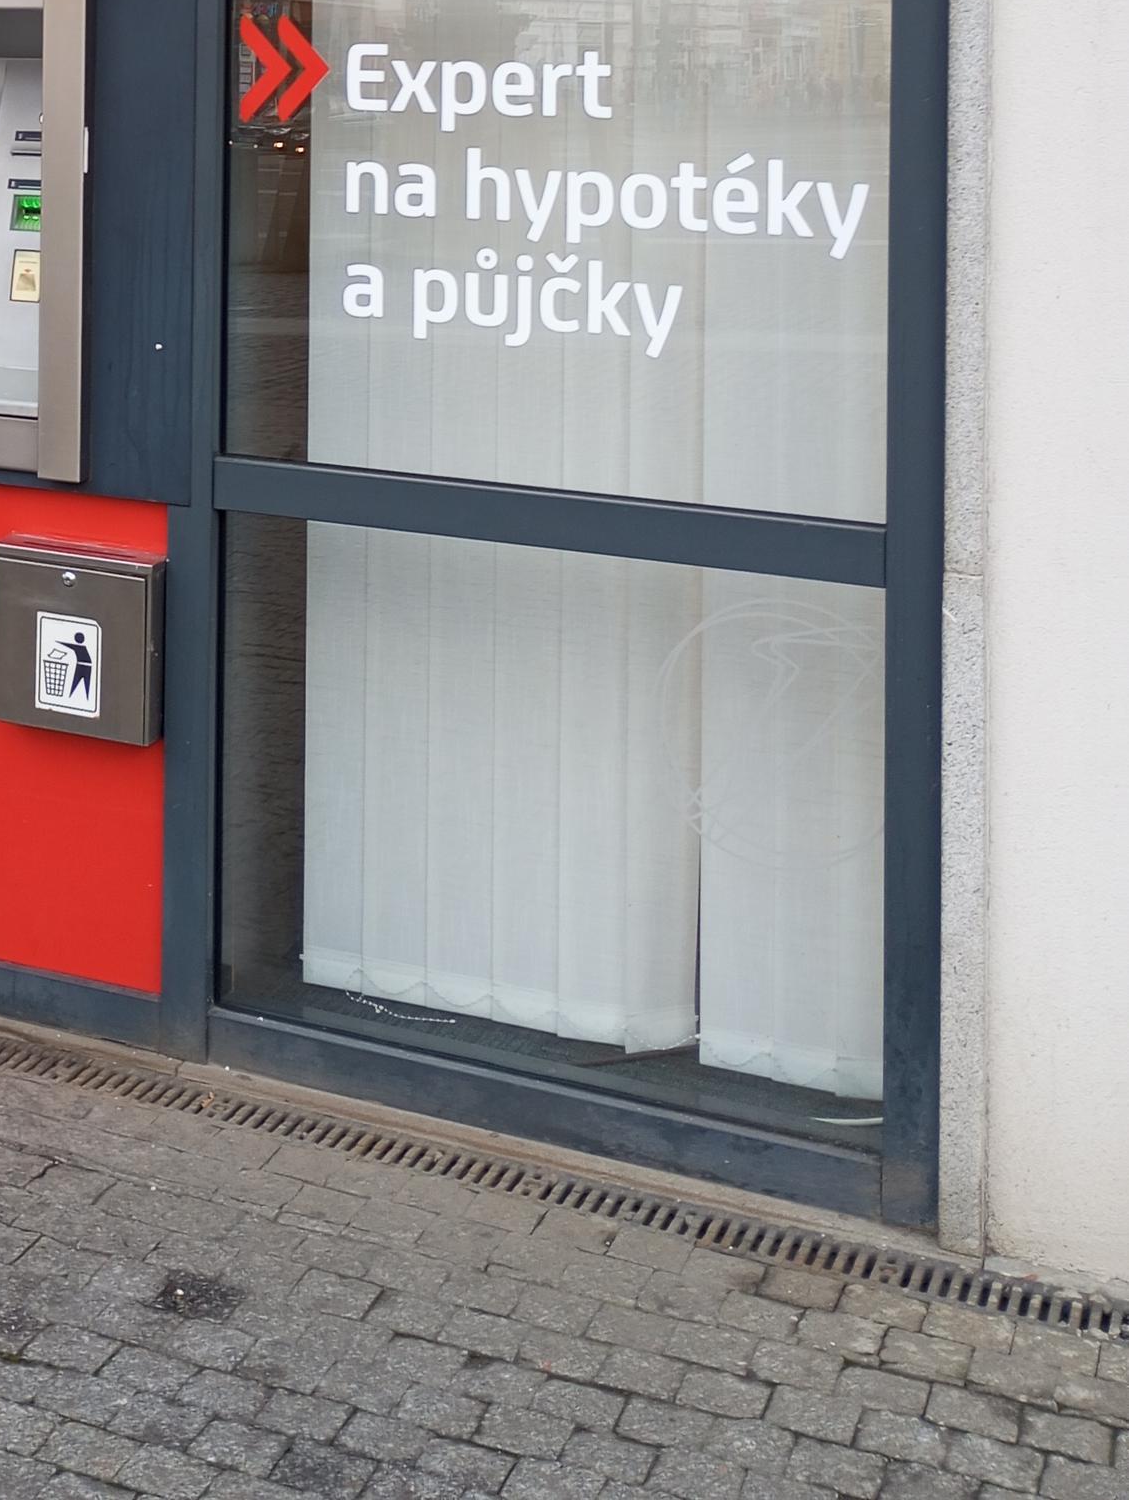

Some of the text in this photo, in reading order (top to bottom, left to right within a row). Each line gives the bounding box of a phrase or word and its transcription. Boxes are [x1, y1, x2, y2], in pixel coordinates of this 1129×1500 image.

[347, 43, 612, 132] Expert
[346, 147, 869, 260] na hypotéky
[342, 248, 683, 358] a půjčky
